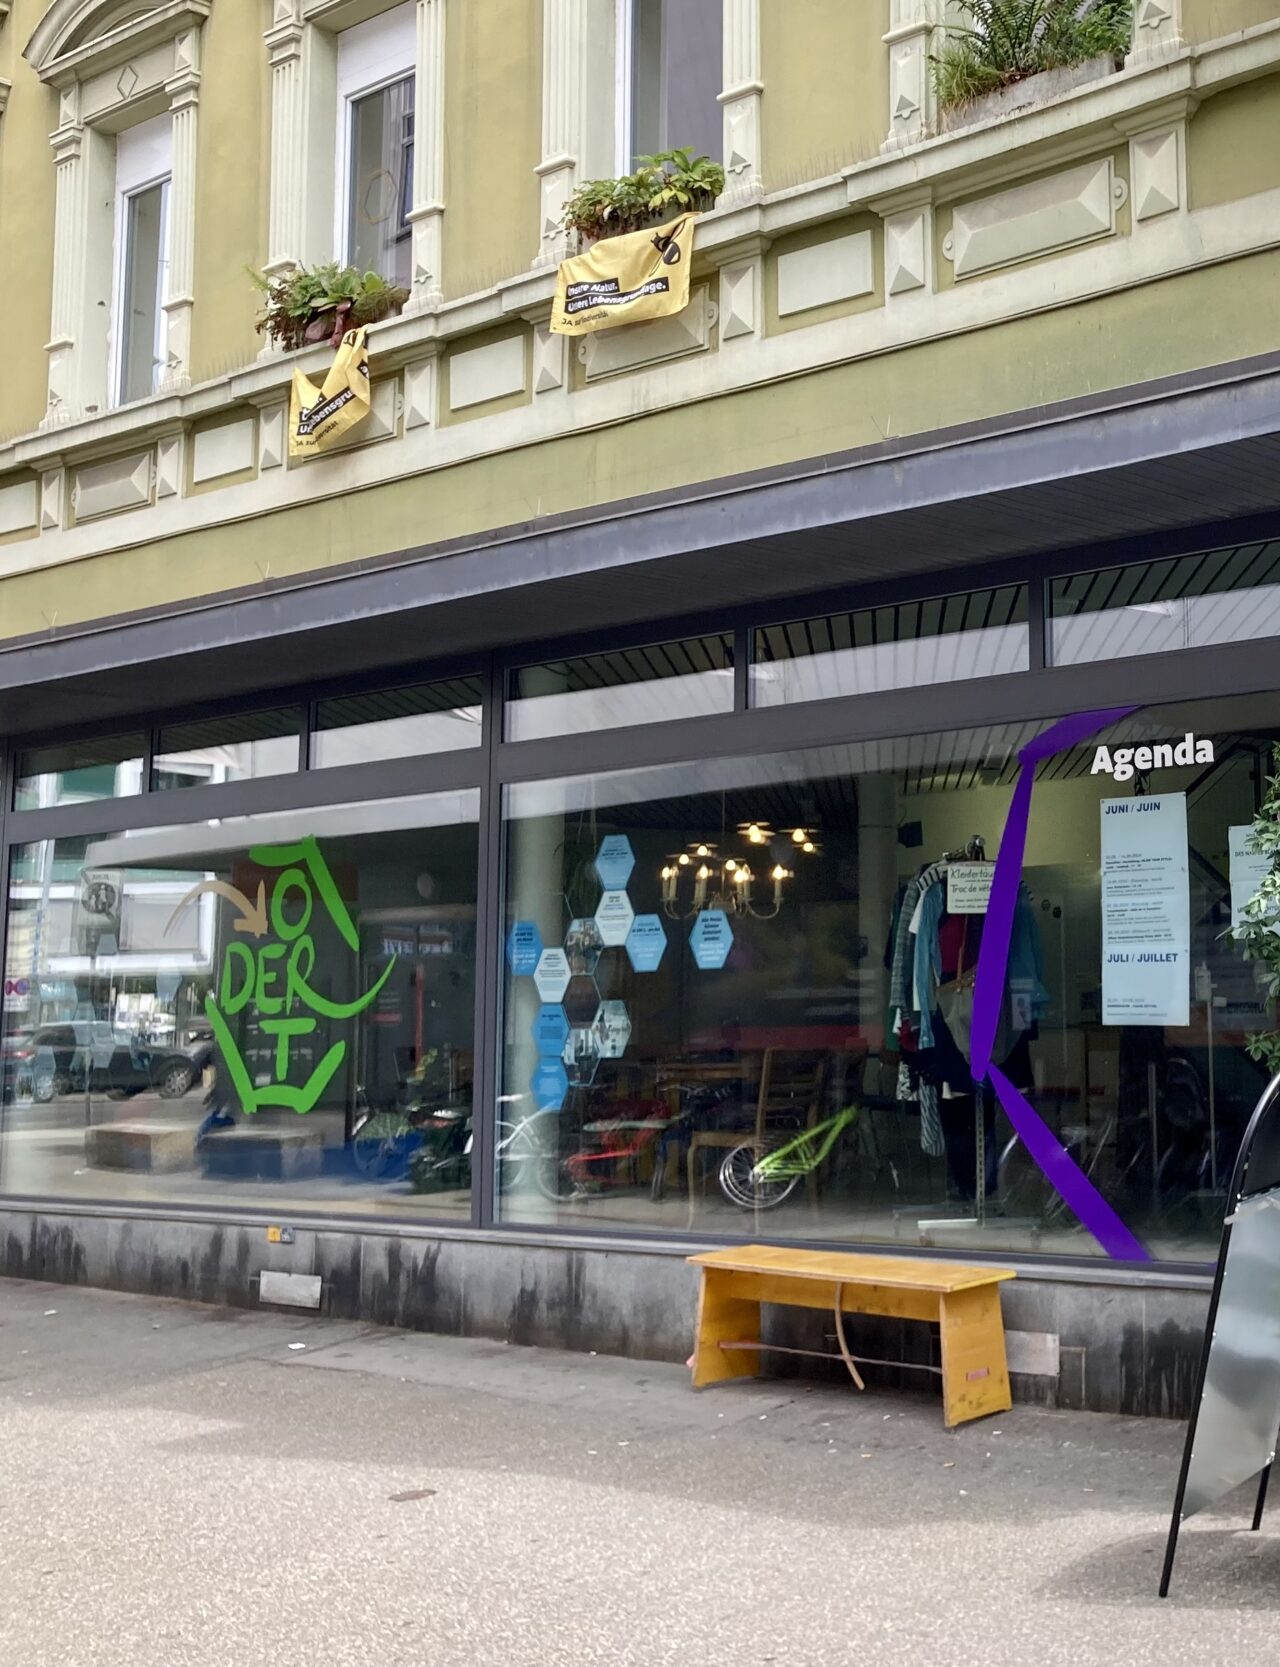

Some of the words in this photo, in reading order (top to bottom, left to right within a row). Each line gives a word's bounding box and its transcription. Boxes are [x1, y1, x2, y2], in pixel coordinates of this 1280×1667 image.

[1090, 732, 1215, 781] Agenda
[1105, 804, 1128, 815] JUNI
[1137, 802, 1160, 812] JUIN
[1107, 953, 1129, 963] JULI
[1137, 952, 1178, 963] JUILLET
